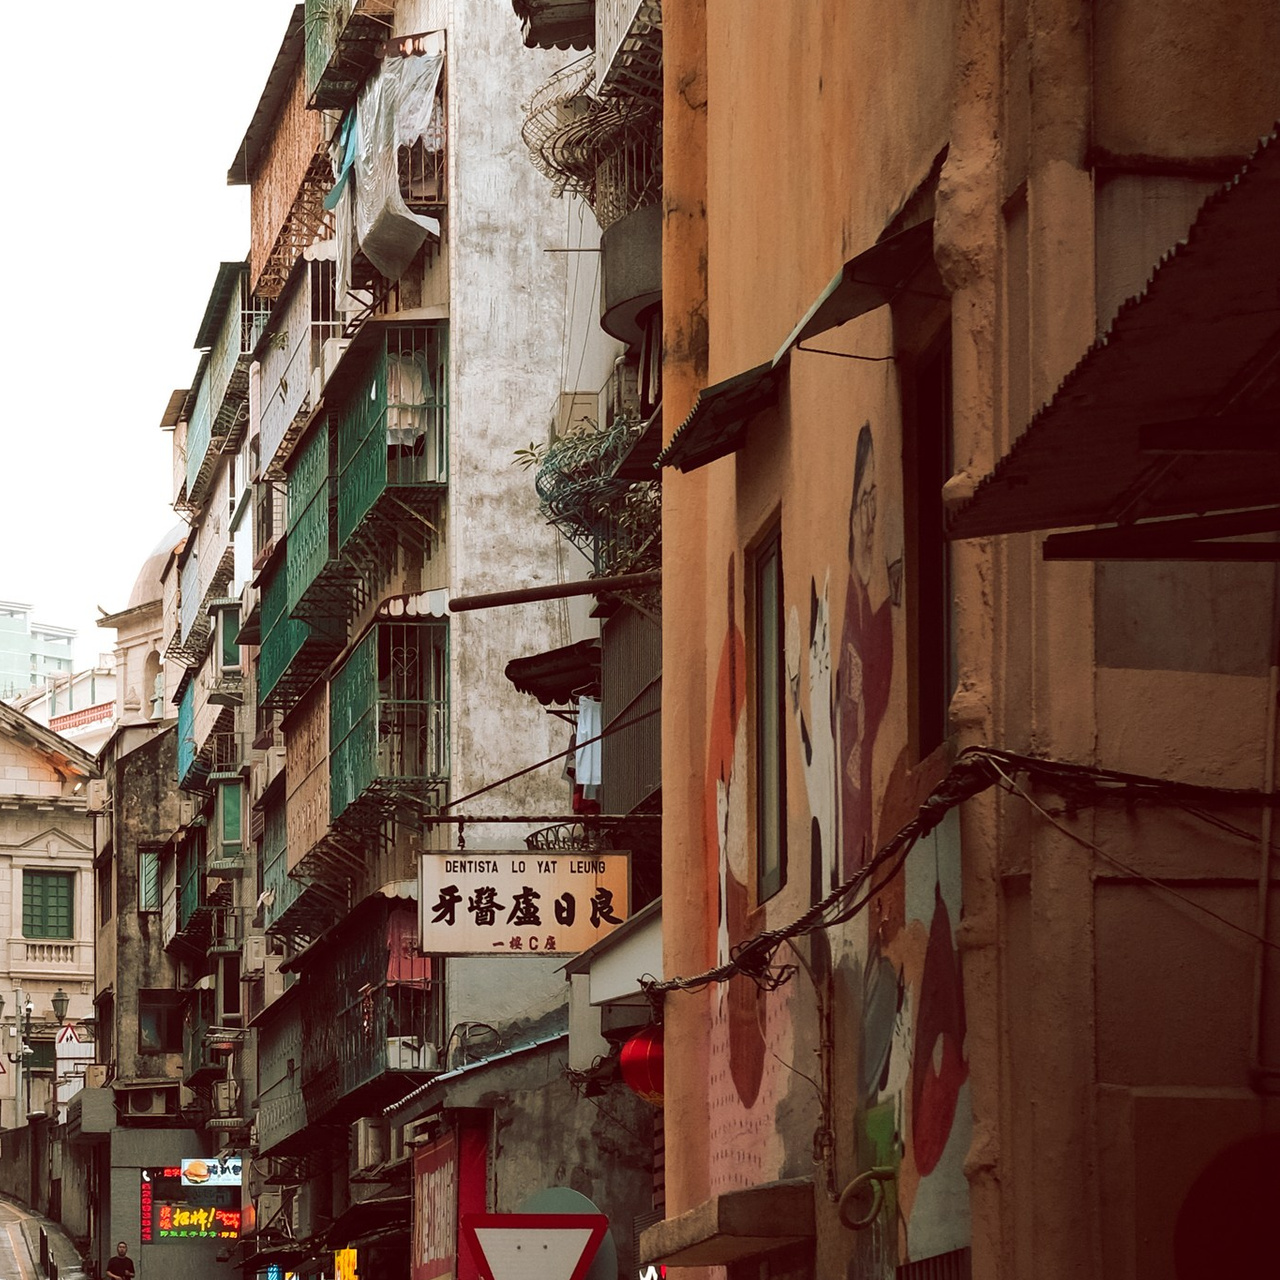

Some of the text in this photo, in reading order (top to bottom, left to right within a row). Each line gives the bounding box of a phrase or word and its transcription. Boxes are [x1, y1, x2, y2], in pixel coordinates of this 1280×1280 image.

[445, 860, 606, 874] DENTISTA LO YAT LEUNG
[430, 884, 625, 929] 牙醫盧日良
